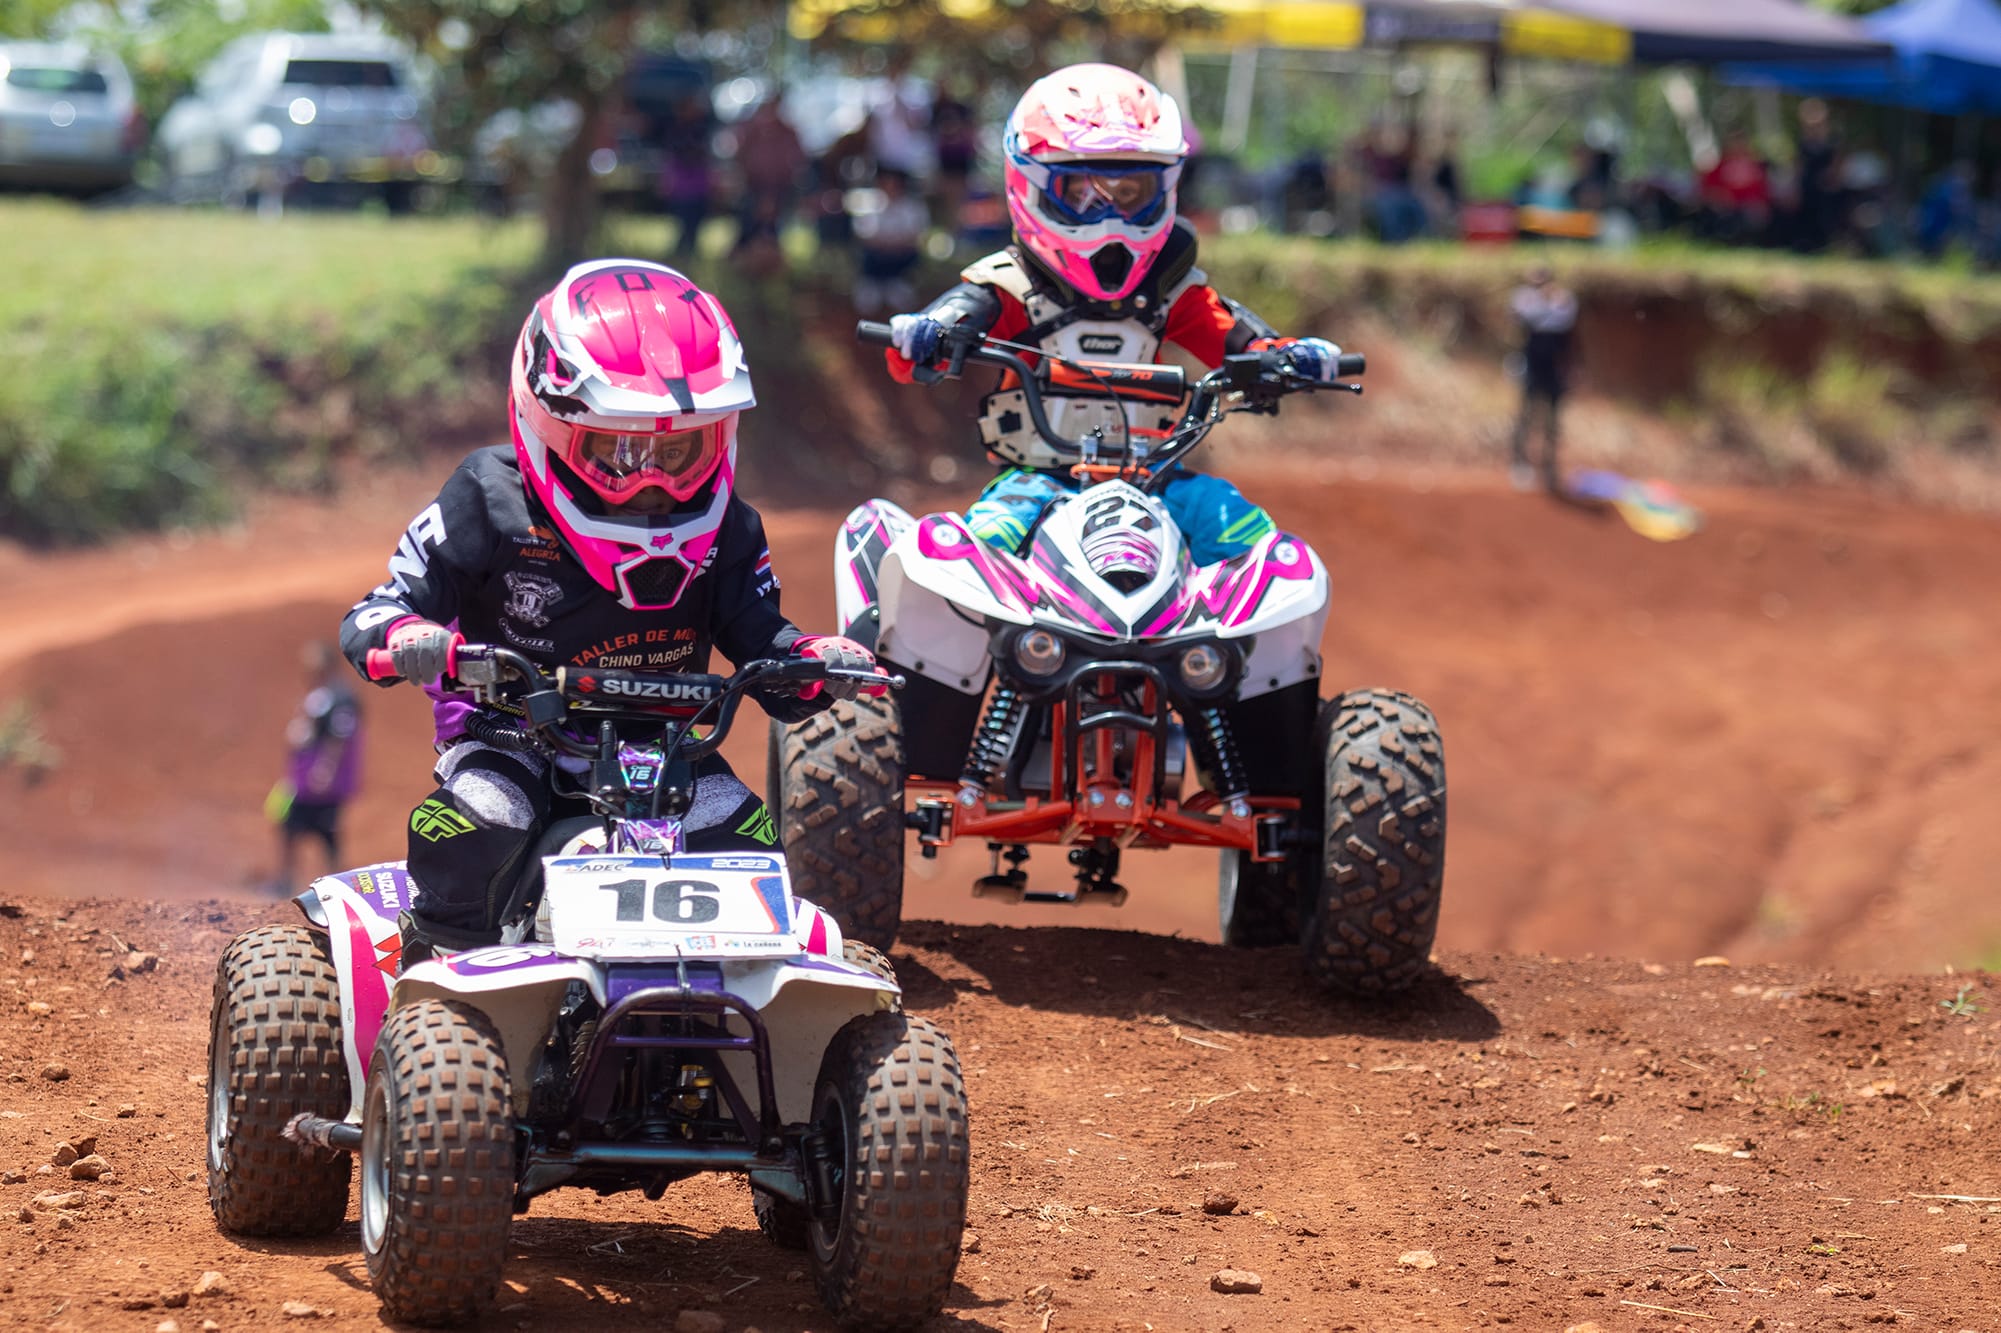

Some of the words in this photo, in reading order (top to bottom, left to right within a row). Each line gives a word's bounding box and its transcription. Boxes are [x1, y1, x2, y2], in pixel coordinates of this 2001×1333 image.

[1082, 337, 1121, 349] thor
[520, 548, 560, 561] ALEGRIA
[571, 632, 639, 667] TALLER
[645, 629, 669, 642] DE
[599, 654, 642, 668] CHINO
[648, 642, 694, 665] VARGAS
[602, 679, 712, 700] SUZUKI
[630, 769, 652, 780] 16
[711, 859, 772, 869] 2023
[375, 871, 401, 909] SUZUKI
[598, 879, 721, 924] 16
